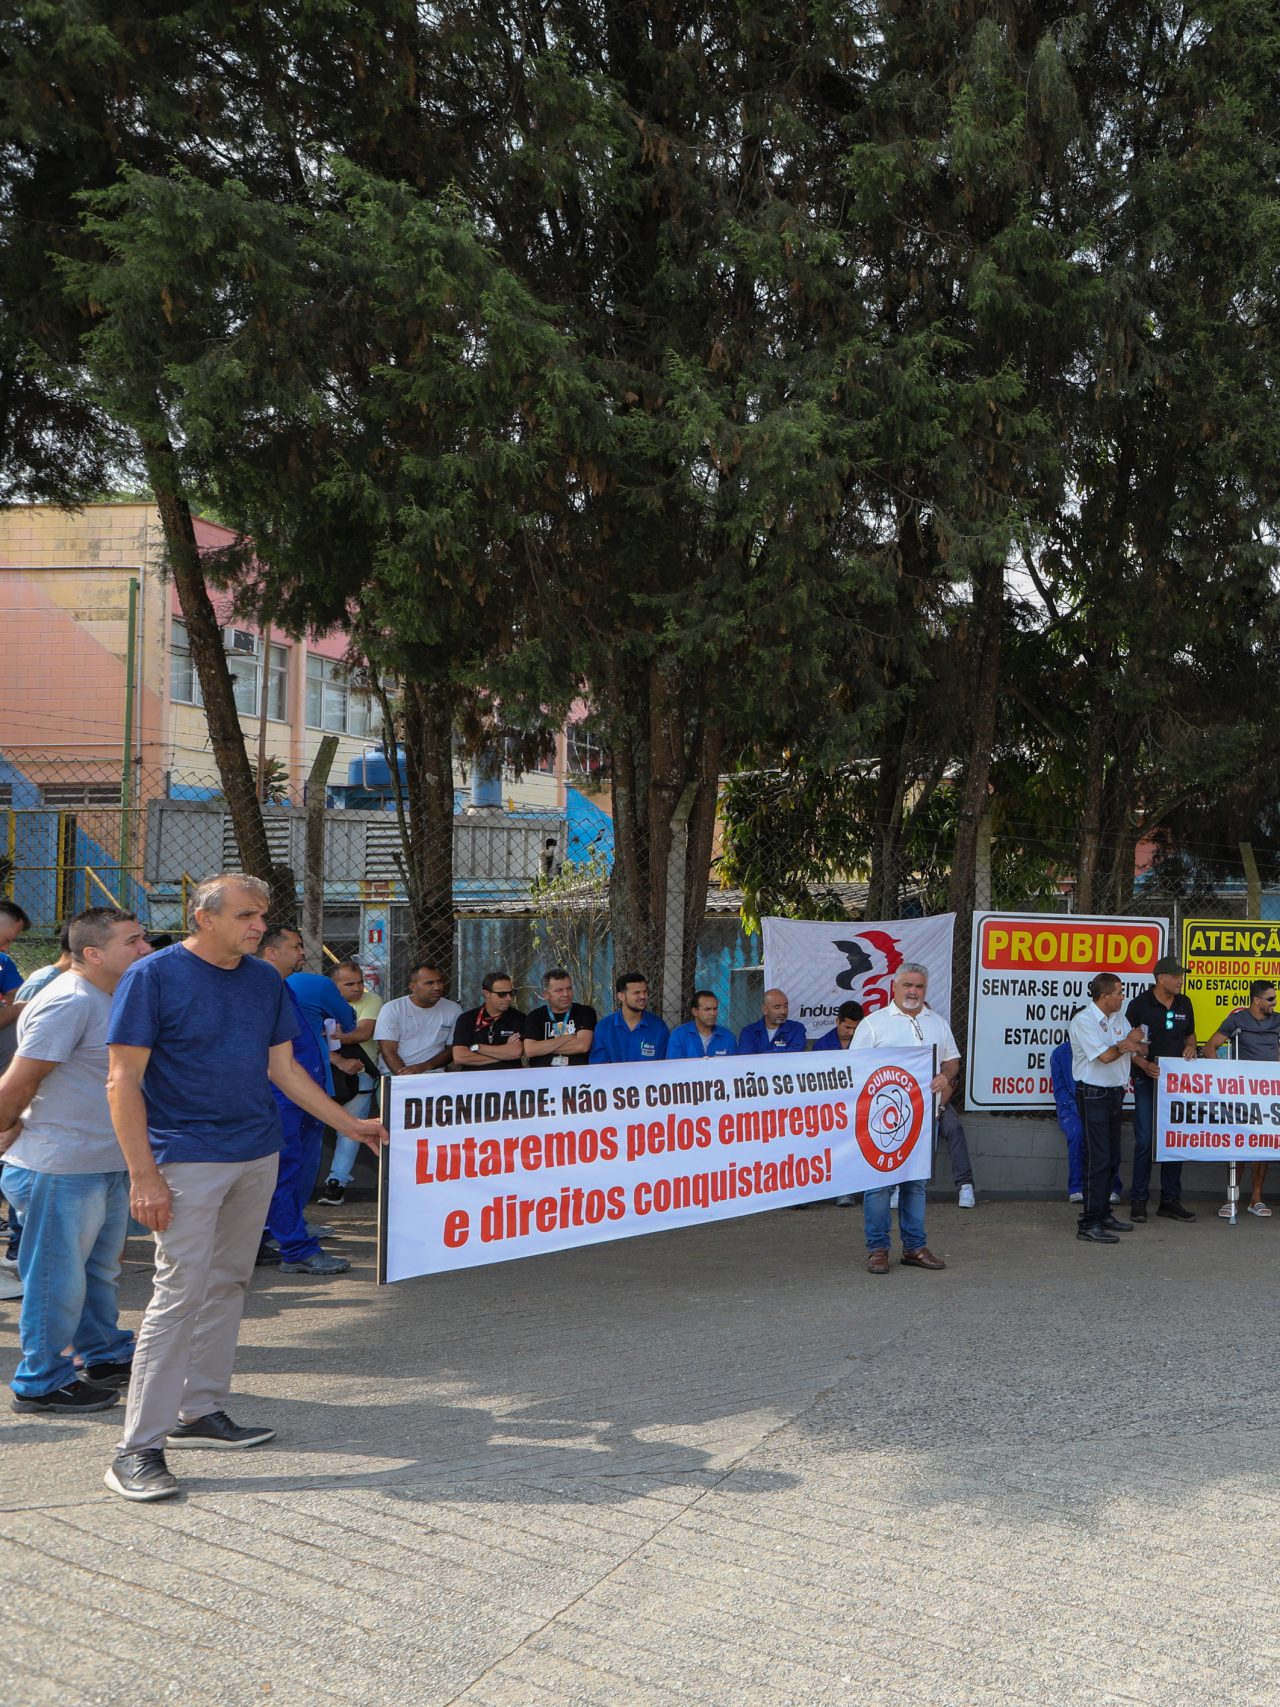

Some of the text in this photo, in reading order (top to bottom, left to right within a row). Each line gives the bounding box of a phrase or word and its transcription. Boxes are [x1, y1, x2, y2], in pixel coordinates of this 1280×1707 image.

[987, 930, 1153, 965] PROIBIDO
[1188, 960, 1250, 975] PROIBIDO
[982, 978, 1059, 997] SENTAR-SE
[1063, 980, 1083, 997] OU
[1188, 979, 1203, 991] NO
[1216, 993, 1250, 1006] DE ÔNI
[800, 1004, 840, 1017] indus
[1026, 1001, 1080, 1021] NO CHÃ
[1004, 1028, 1070, 1045] ESTACION
[1027, 1053, 1045, 1069] DE
[868, 1069, 914, 1095] QUÍMICOS
[992, 1076, 1035, 1094] RISCO
[1166, 1073, 1213, 1095] BASF
[1217, 1075, 1244, 1095] vai
[404, 1065, 854, 1130] DIGNIDADE: Não se compra, não se vende!
[415, 1101, 849, 1185] Lutaremos pelos empregos
[1165, 1130, 1231, 1148] Direitos
[1234, 1133, 1245, 1148] e
[443, 1148, 832, 1249] e direitos conquistados!
